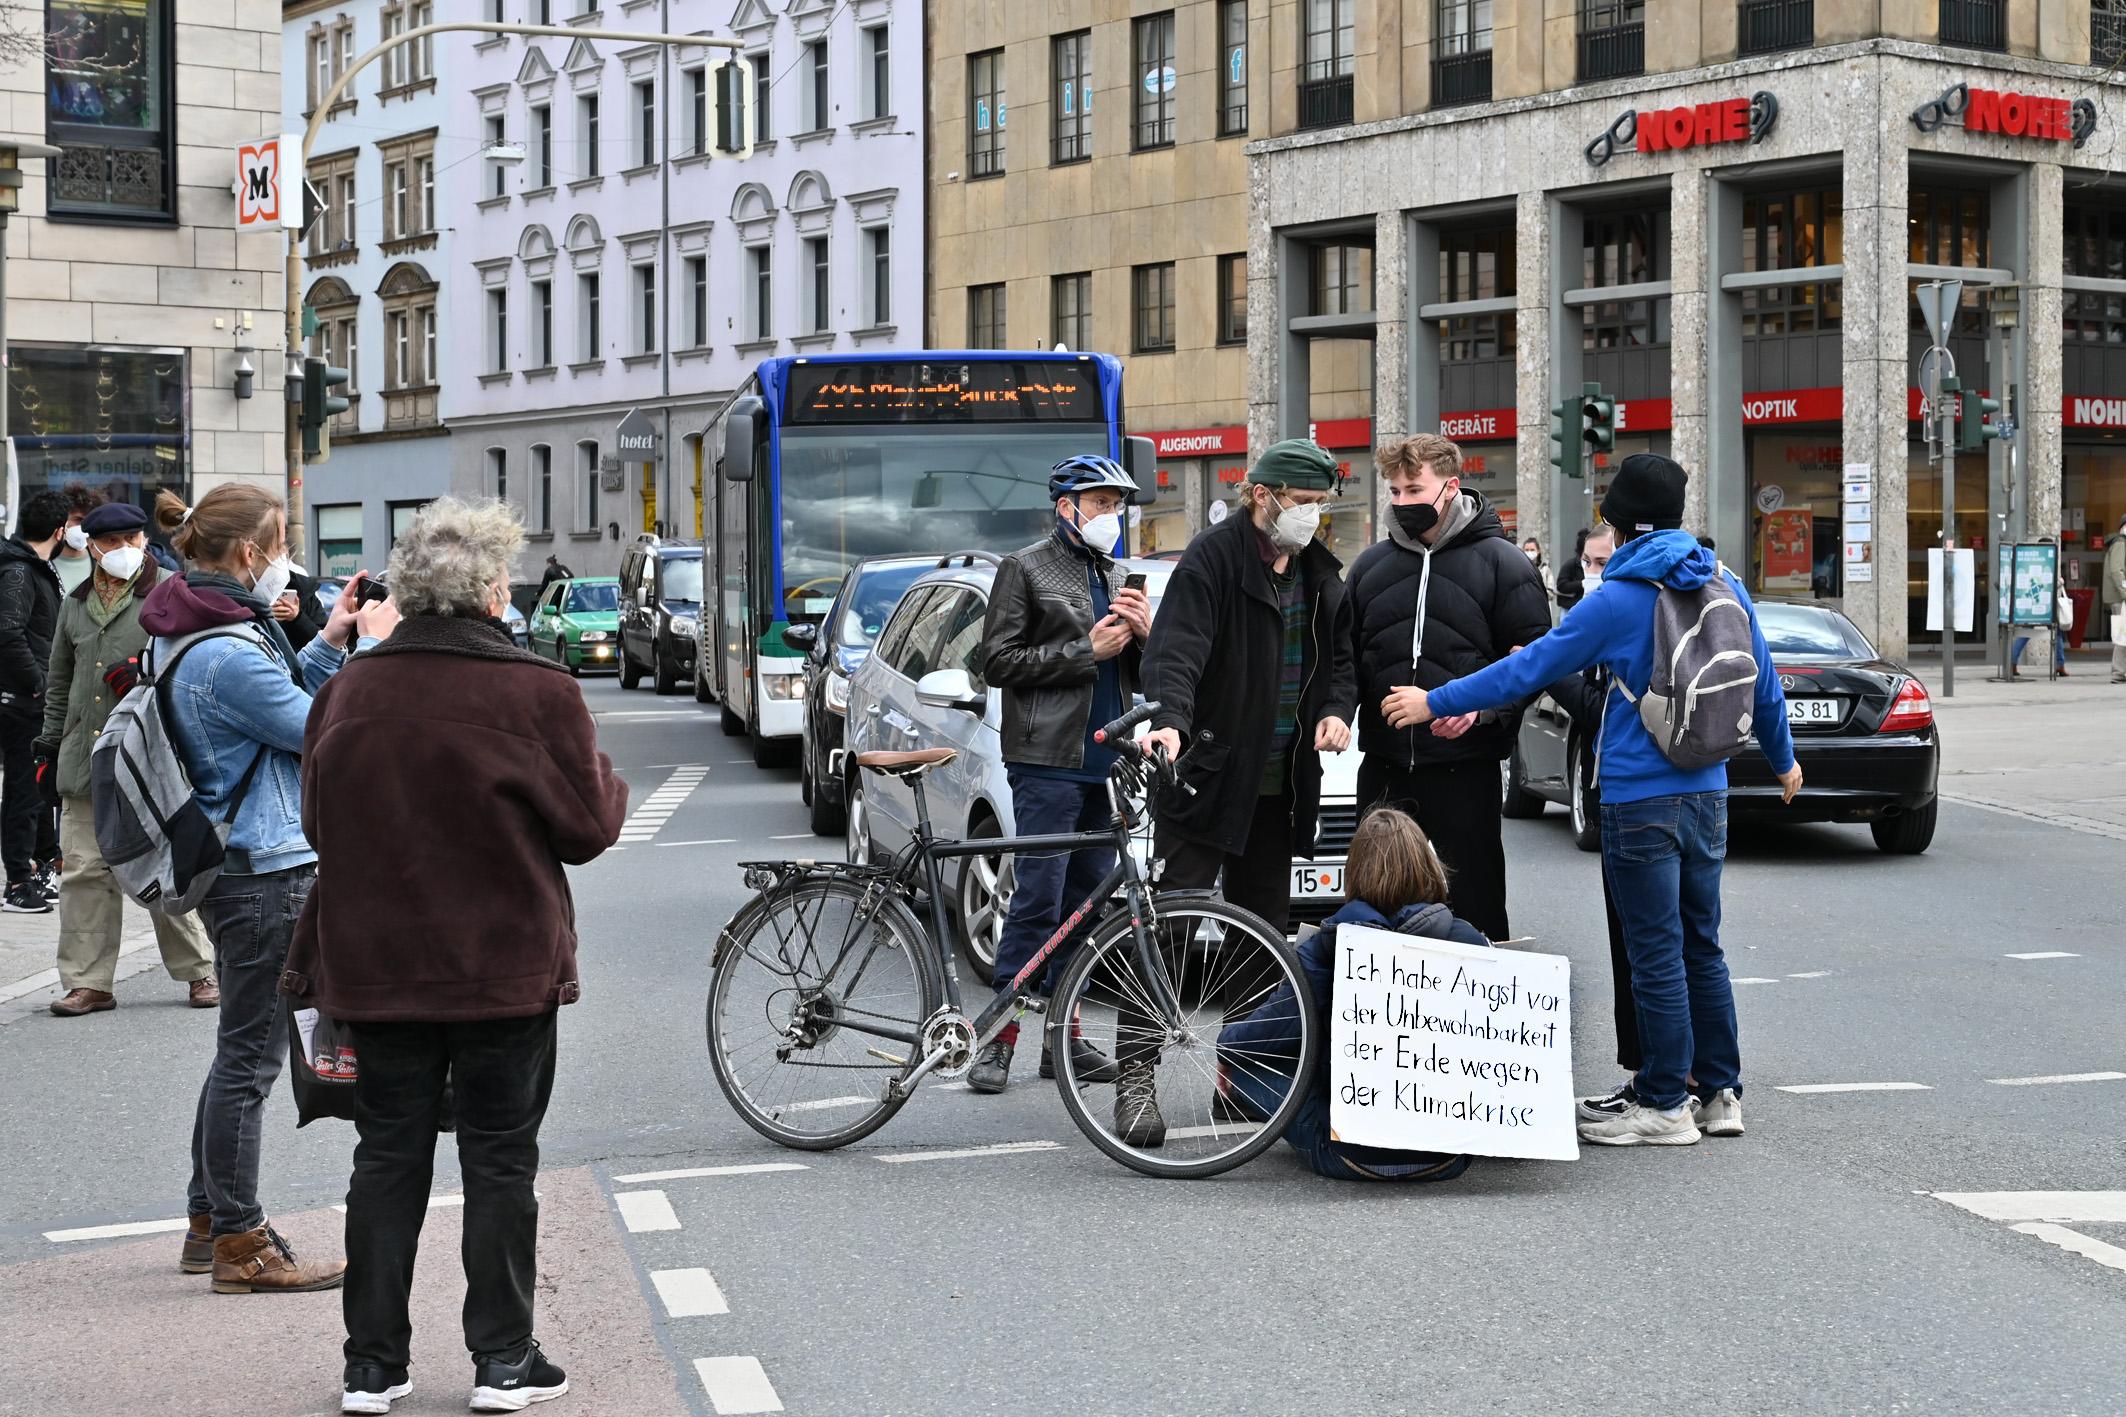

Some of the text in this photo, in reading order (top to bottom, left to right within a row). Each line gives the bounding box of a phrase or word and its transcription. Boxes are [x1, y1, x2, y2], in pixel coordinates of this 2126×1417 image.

[1637, 98, 1750, 153] NOHE
[1965, 88, 2074, 142] NOHE
[249, 166, 269, 201] M
[620, 434, 654, 449] hotel
[1160, 436, 1222, 452] AUGENOPTIK
[1811, 702, 1832, 718] 81
[1295, 869, 1317, 893] 15
[1346, 948, 1561, 1012] Ich habe Angst vor
[1342, 992, 1557, 1048] der Unbewohnbarkeit
[1344, 1031, 1539, 1087] der Erde wegen
[1341, 1072, 1534, 1127] der Klimakrise
